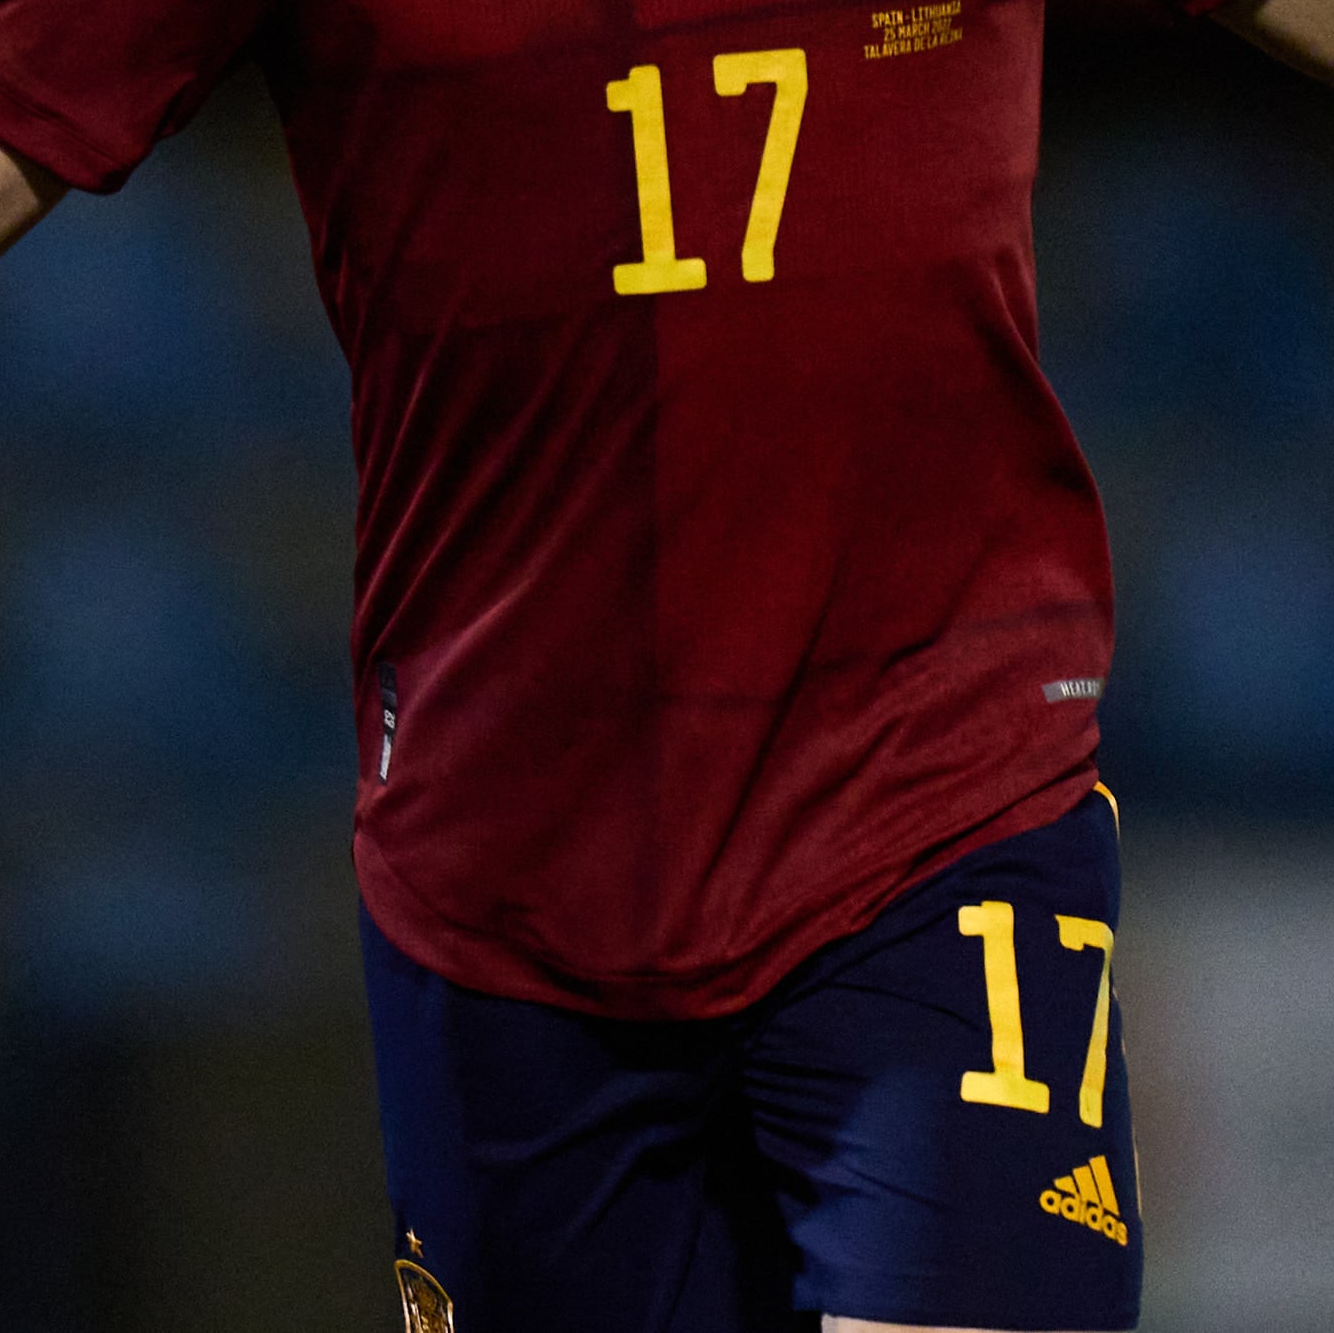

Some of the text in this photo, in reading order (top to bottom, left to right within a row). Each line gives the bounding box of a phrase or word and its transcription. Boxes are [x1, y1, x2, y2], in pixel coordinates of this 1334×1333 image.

[871, 10, 904, 29] SPAIN
[898, 21, 930, 40] MARCH
[605, 47, 809, 296] 17
[957, 899, 1115, 1130] 17
[1038, 1187, 1129, 1247] adidas
